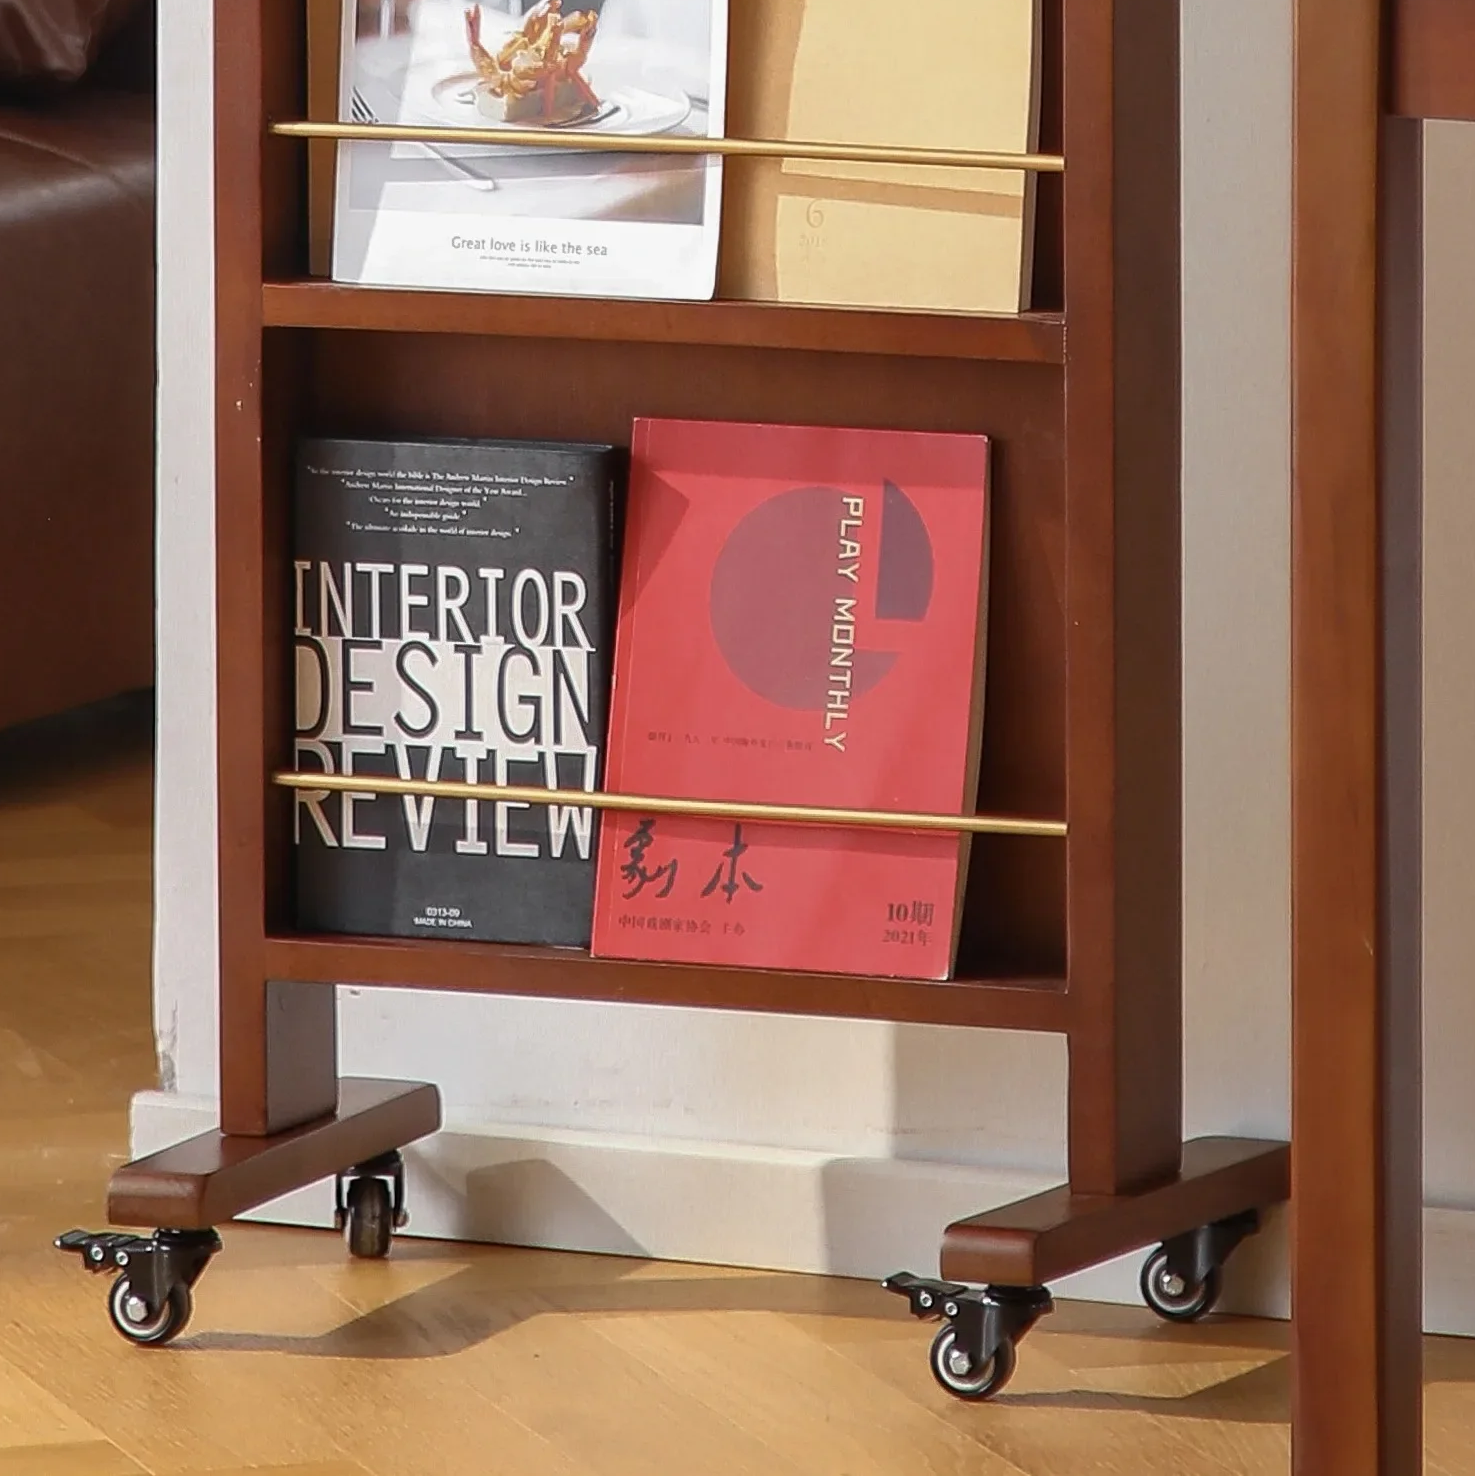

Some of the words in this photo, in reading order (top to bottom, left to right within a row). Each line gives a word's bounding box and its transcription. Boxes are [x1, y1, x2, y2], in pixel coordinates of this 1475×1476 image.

[806, 198, 824, 228] 6
[451, 236, 486, 250] Great
[490, 237, 516, 252] love
[520, 239, 531, 252] is
[535, 240, 558, 254] like
[562, 242, 582, 255] the
[587, 245, 608, 256] sea
[837, 496, 865, 583] PLAY
[294, 561, 593, 650] INTERIOR
[294, 637, 590, 748] DESIGN
[823, 598, 858, 753] MONTHLY
[294, 740, 597, 861] REVIEW
[413, 917, 436, 927] MADE
[438, 918, 447, 927] IN
[448, 918, 473, 928] CHINA
[882, 929, 932, 947] 2021年
[886, 900, 935, 927] 10期
